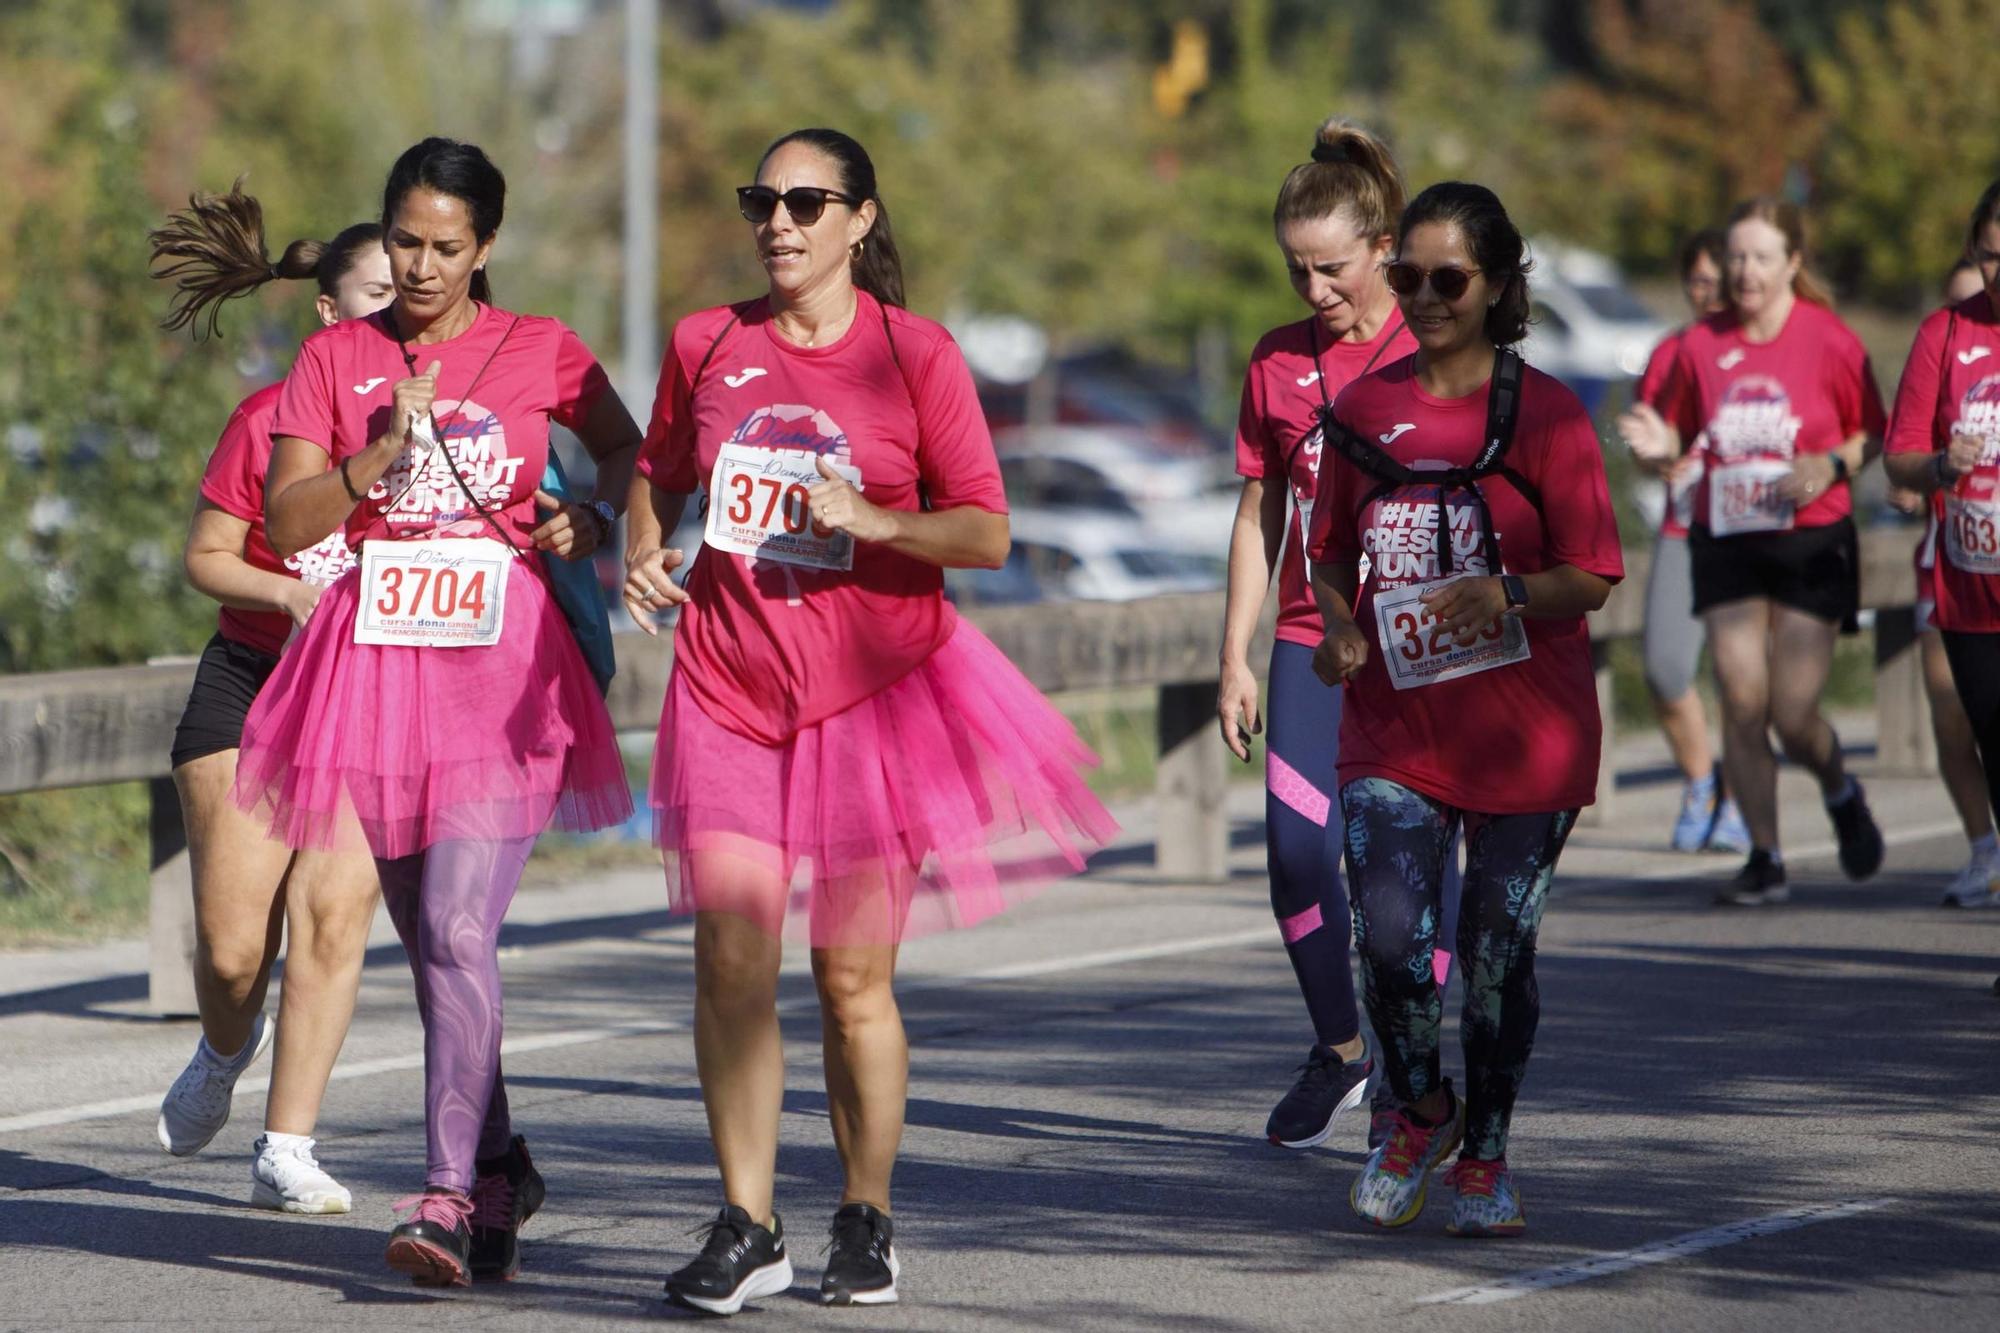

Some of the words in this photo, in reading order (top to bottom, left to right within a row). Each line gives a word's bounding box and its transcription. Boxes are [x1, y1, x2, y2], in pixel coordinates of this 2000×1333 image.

[1475, 438, 1500, 470] Quechua
[728, 473, 834, 539] 370
[730, 526, 765, 539] cursa
[768, 533, 797, 545] dona
[377, 567, 486, 619] 3704
[380, 619, 413, 627] cursa
[417, 618, 445, 628] dona
[1410, 657, 1443, 670] cursa
[1446, 648, 1473, 662] dona
